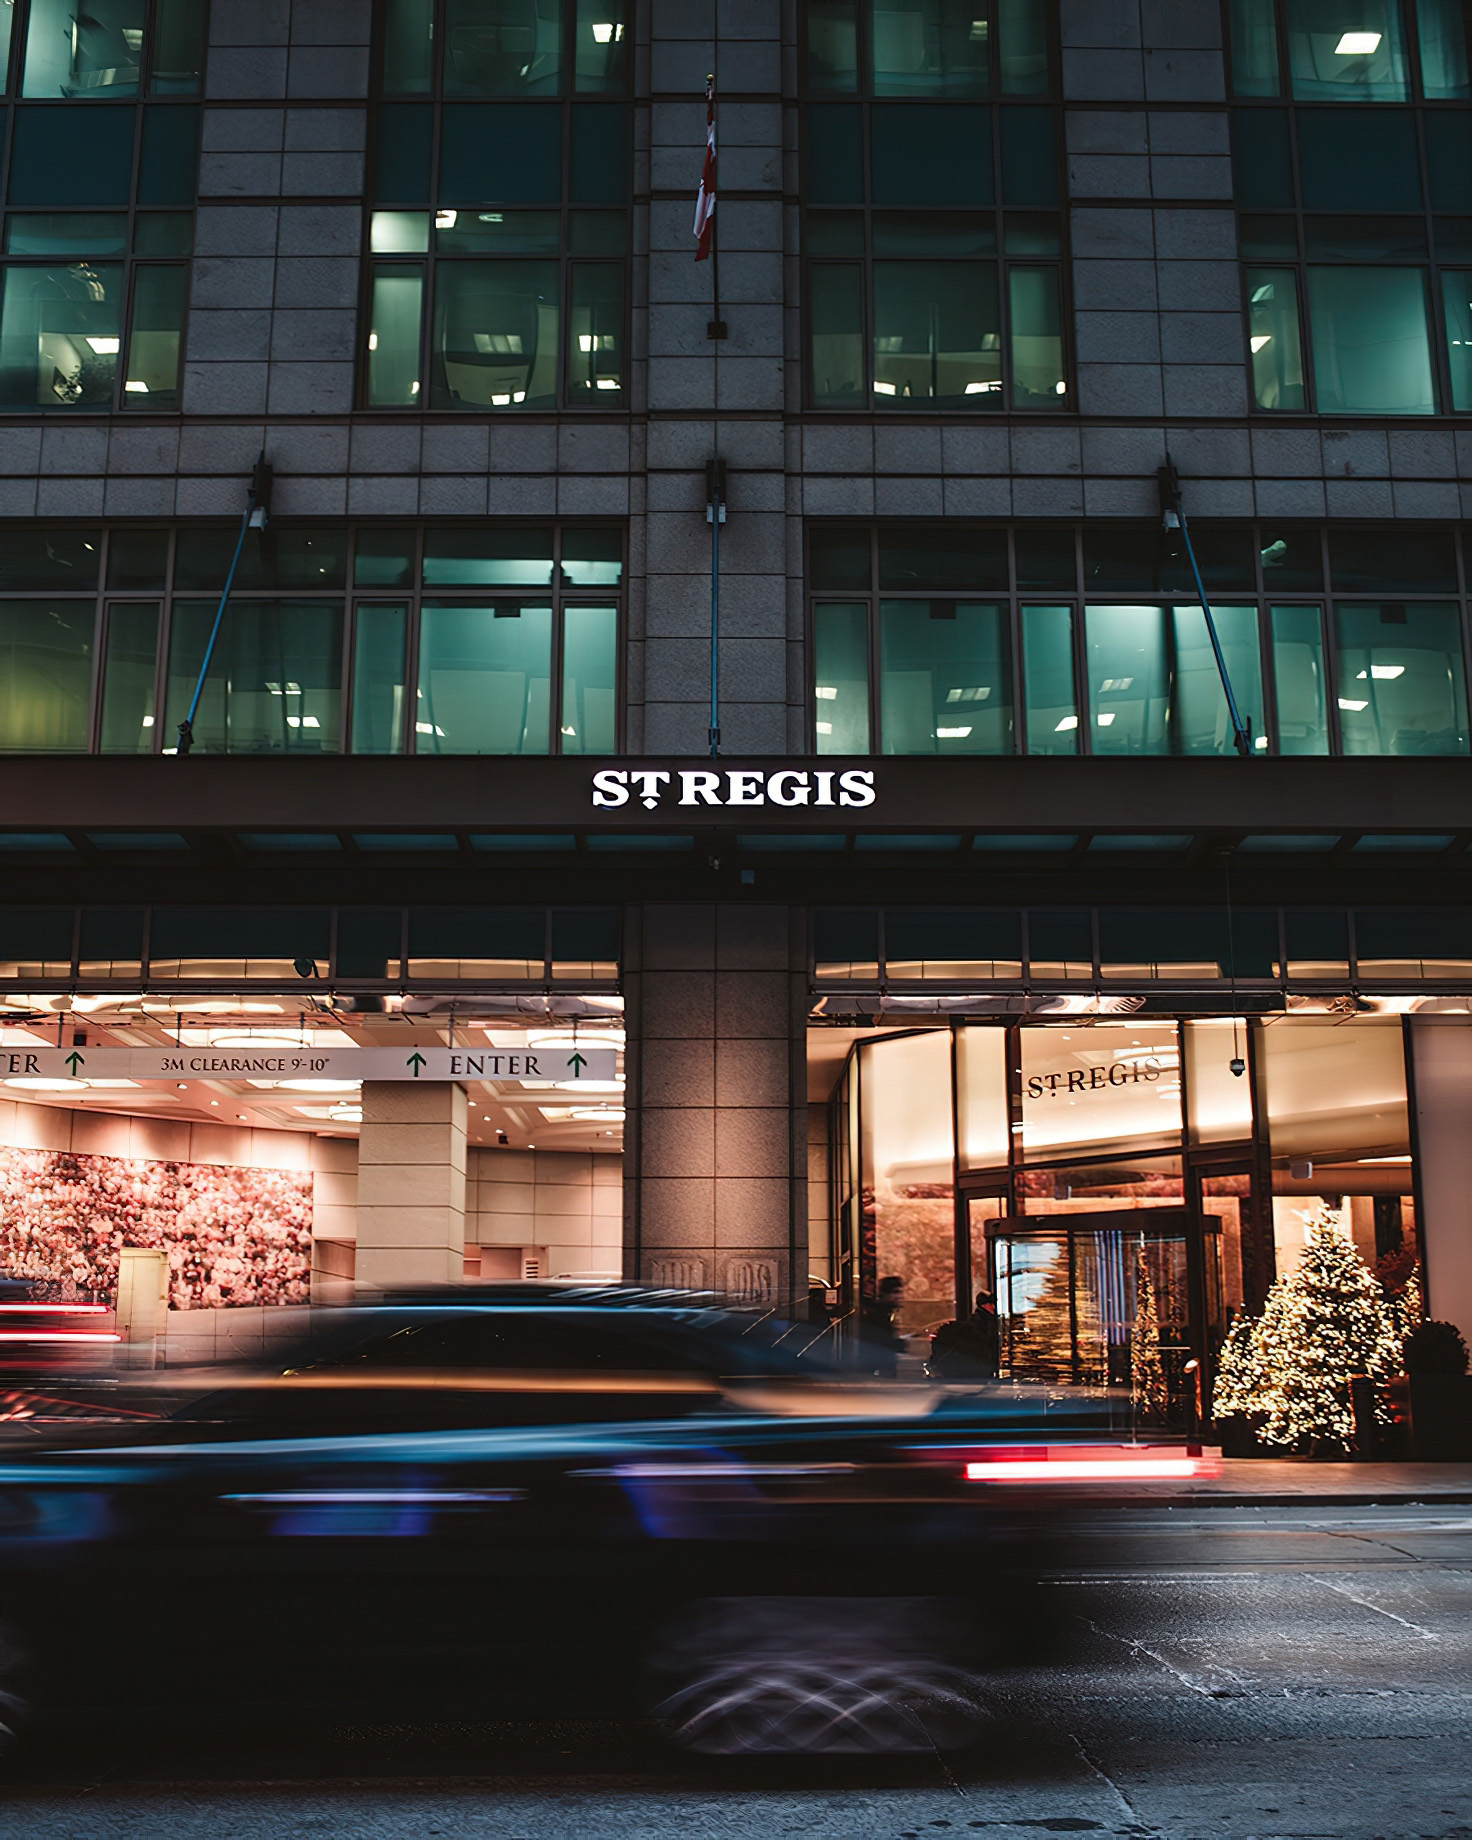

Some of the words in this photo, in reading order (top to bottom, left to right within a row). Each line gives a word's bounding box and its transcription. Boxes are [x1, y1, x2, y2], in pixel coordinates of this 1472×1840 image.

[677, 770, 876, 807] REGIS
[161, 1058, 184, 1071] 3M
[190, 1058, 286, 1071] CLEARANCE
[450, 1055, 542, 1075] ENTER
[1067, 1057, 1160, 1092] REGIS
